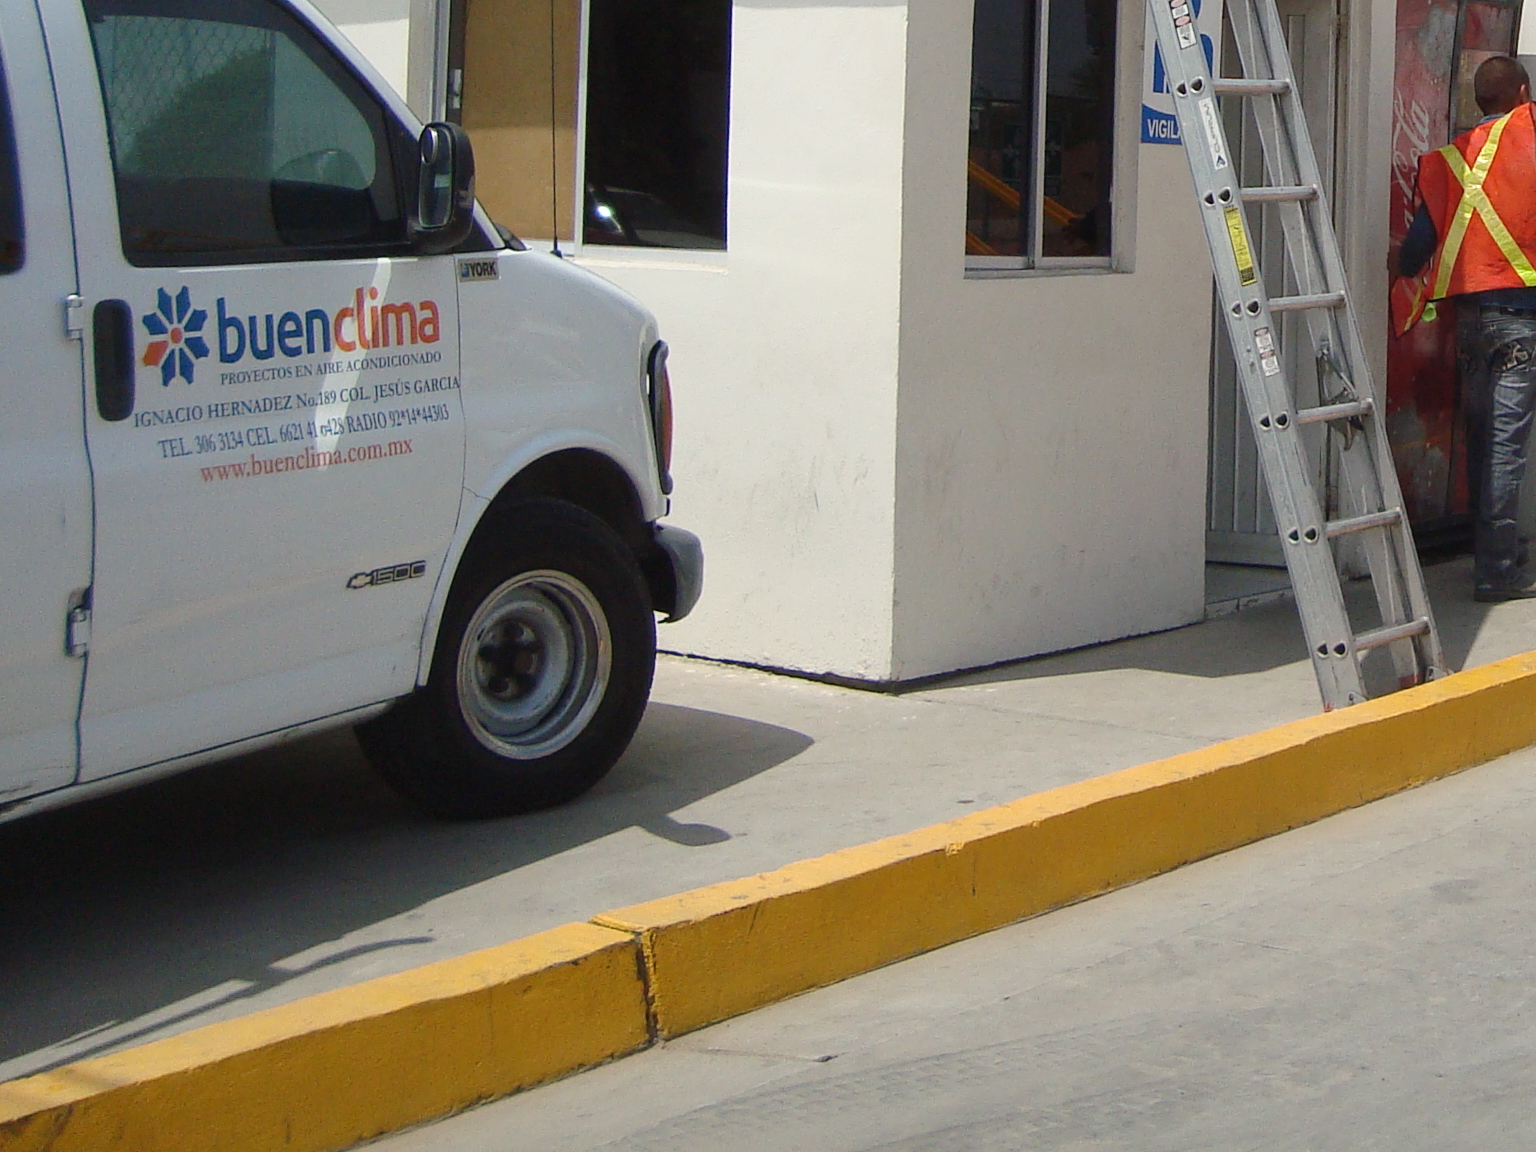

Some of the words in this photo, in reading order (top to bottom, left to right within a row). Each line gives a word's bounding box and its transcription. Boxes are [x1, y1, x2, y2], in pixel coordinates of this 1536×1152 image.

[1147, 118, 1181, 139] VIGIL
[470, 261, 497, 277] YORK
[217, 287, 440, 364] buenclima
[220, 365, 293, 386] PROYECTOS
[296, 364, 313, 378] EN
[316, 361, 343, 376] AIRE
[346, 351, 442, 372] ACONDICIONADO
[134, 405, 203, 428] IGNACIO
[208, 395, 293, 419] HERNADEZ
[340, 387, 371, 403] COL.
[373, 378, 411, 404] JESÚS
[413, 375, 461, 394] GARCIA
[158, 437, 193, 458] TEL.
[194, 433, 217, 454] 306
[218, 429, 244, 452] 3134
[246, 426, 278, 447] CEL.
[347, 410, 387, 434] RADIO
[200, 438, 413, 483] www.buenclima.com.mx
